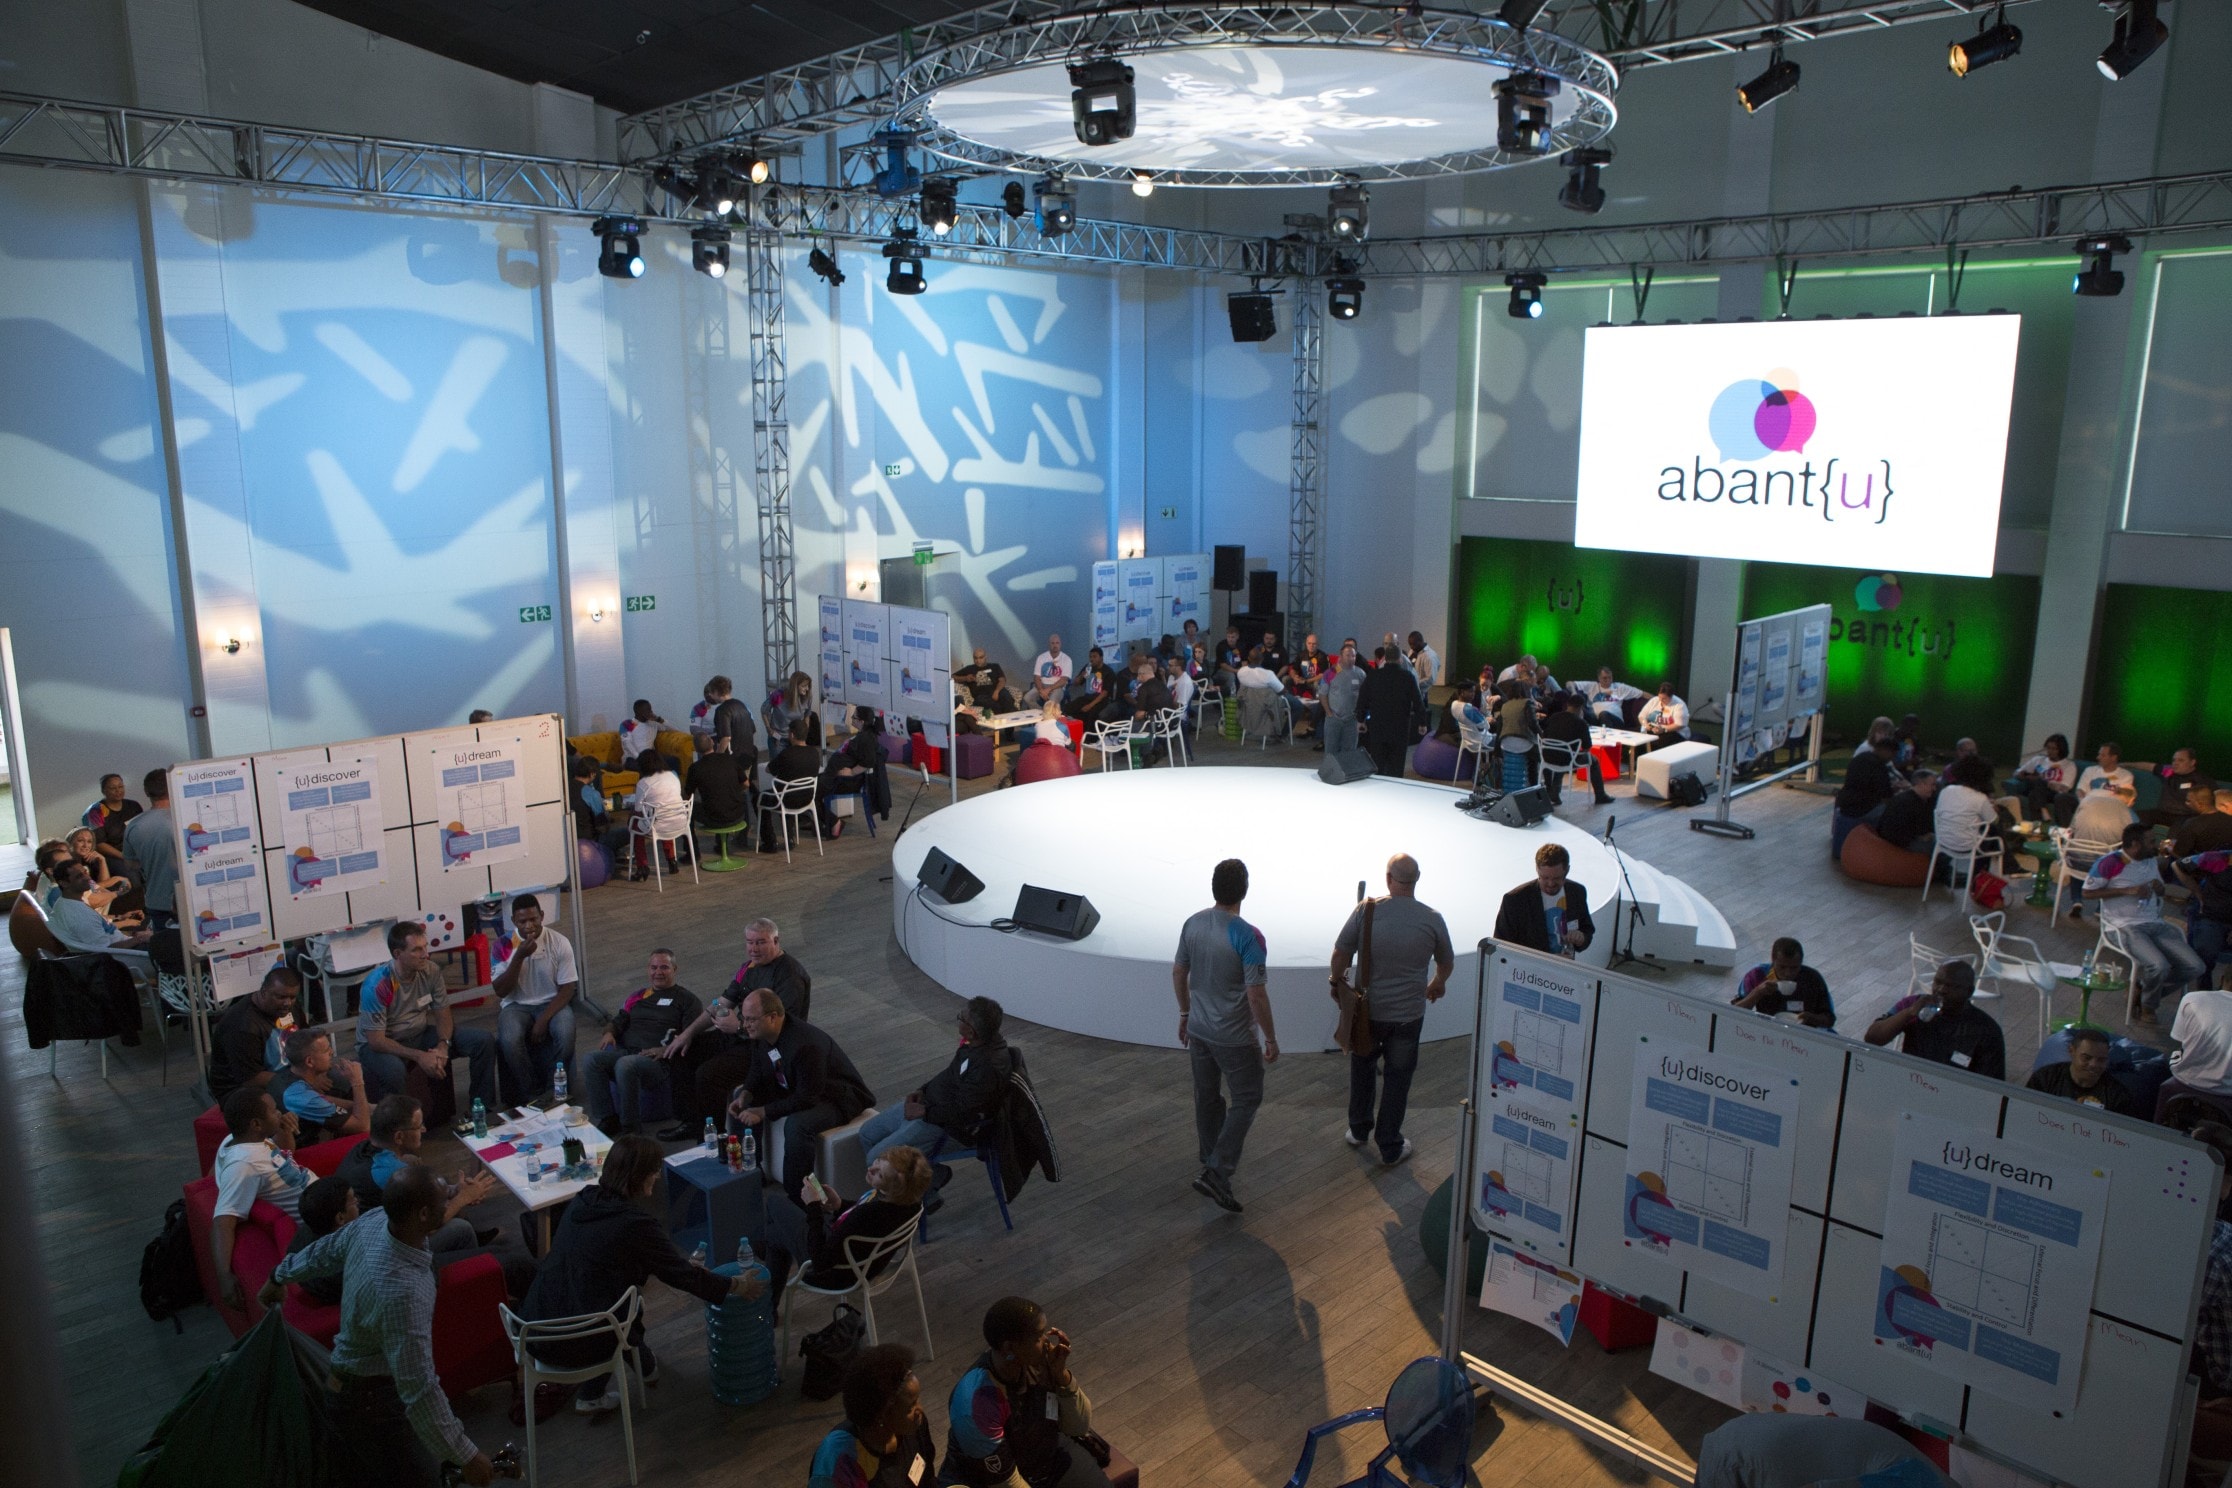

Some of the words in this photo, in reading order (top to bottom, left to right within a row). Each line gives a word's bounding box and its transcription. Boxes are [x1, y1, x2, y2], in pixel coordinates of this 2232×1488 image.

[1657, 455, 1894, 524] abant{u}
[1547, 577, 1584, 614] {u}
[1829, 617, 1956, 660] bant{u}
[1910, 1072, 1939, 1094] Mean
[2037, 1111, 2064, 1131] Does
[2073, 1121, 2091, 1139] Not
[1954, 1210, 1983, 1227] Flexibility
[1984, 1219, 1996, 1230] and
[1997, 1224, 2030, 1241] Discretion
[1946, 1301, 1971, 1318] Stability
[1971, 1312, 1983, 1321] and
[1984, 1316, 2008, 1330] Control
[2101, 1321, 2147, 1352] Mean
